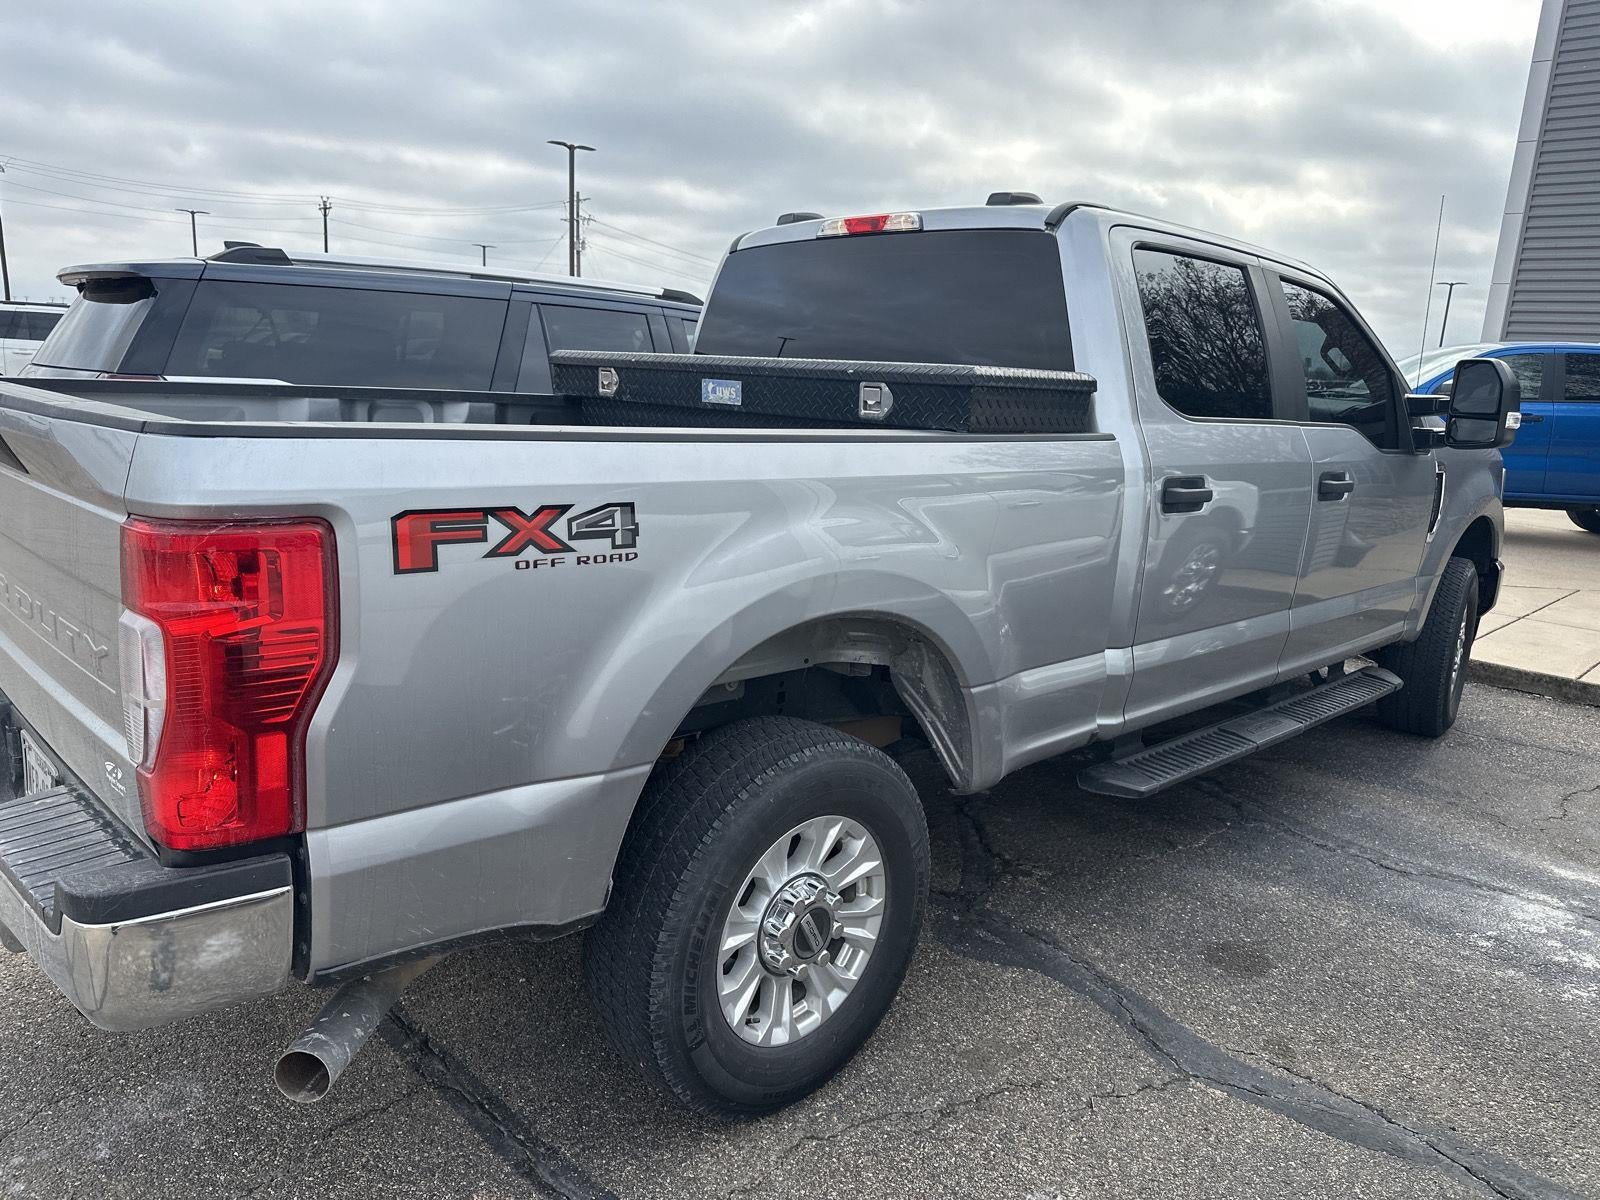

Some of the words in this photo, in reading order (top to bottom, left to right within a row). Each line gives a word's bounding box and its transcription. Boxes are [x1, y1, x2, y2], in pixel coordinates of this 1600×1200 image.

[391, 502, 639, 575] FX4
[514, 557, 566, 570] OFF
[576, 552, 639, 566] ROAD
[805, 920, 820, 946] FORD
